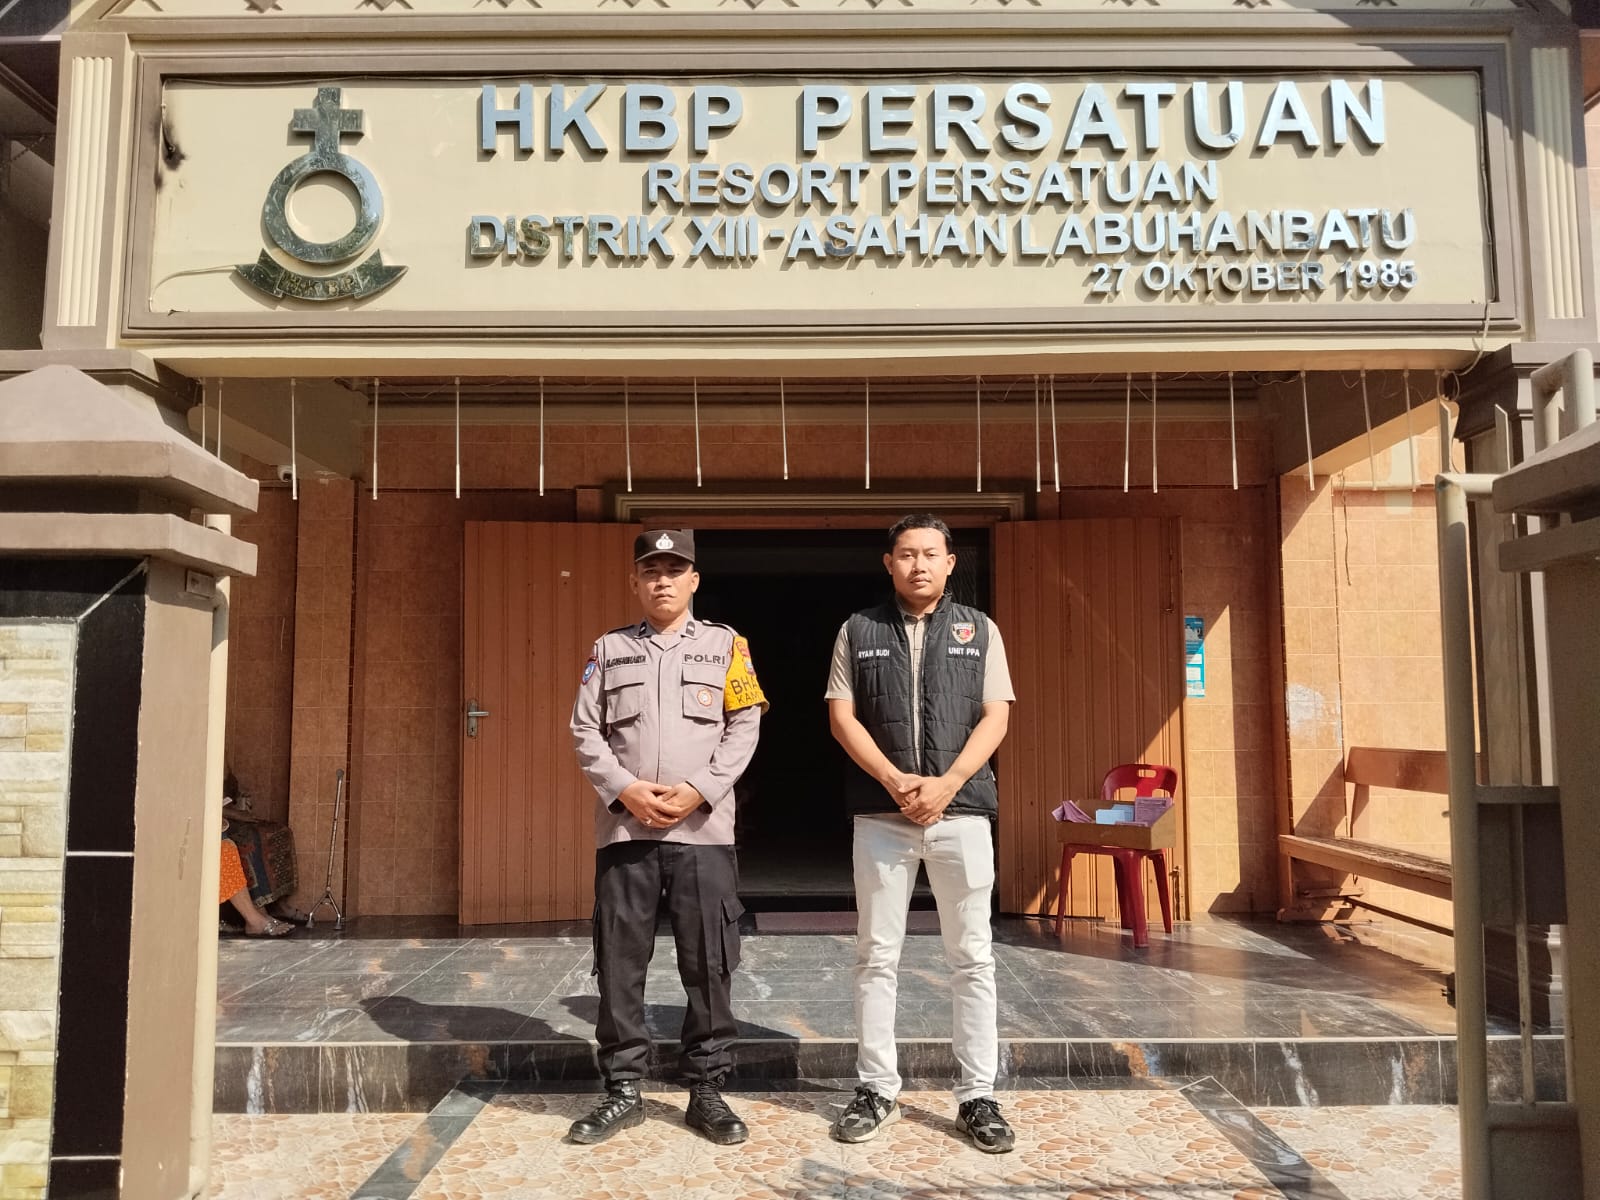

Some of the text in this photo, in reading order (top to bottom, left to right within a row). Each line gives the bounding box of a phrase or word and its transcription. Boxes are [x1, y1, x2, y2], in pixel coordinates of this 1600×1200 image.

[481, 79, 1386, 154] HKBP PERSATUAN
[648, 160, 1218, 206] RESORT PERSATUAN
[469, 214, 675, 260] DISTRIK
[1020, 208, 1416, 257] LABUHANBATU
[1090, 260, 1417, 294] 27 OKTOBER 1985
[684, 653, 725, 665] POLRI
[876, 649, 890, 657] BUDI
[948, 647, 980, 657] UNIT PPA
